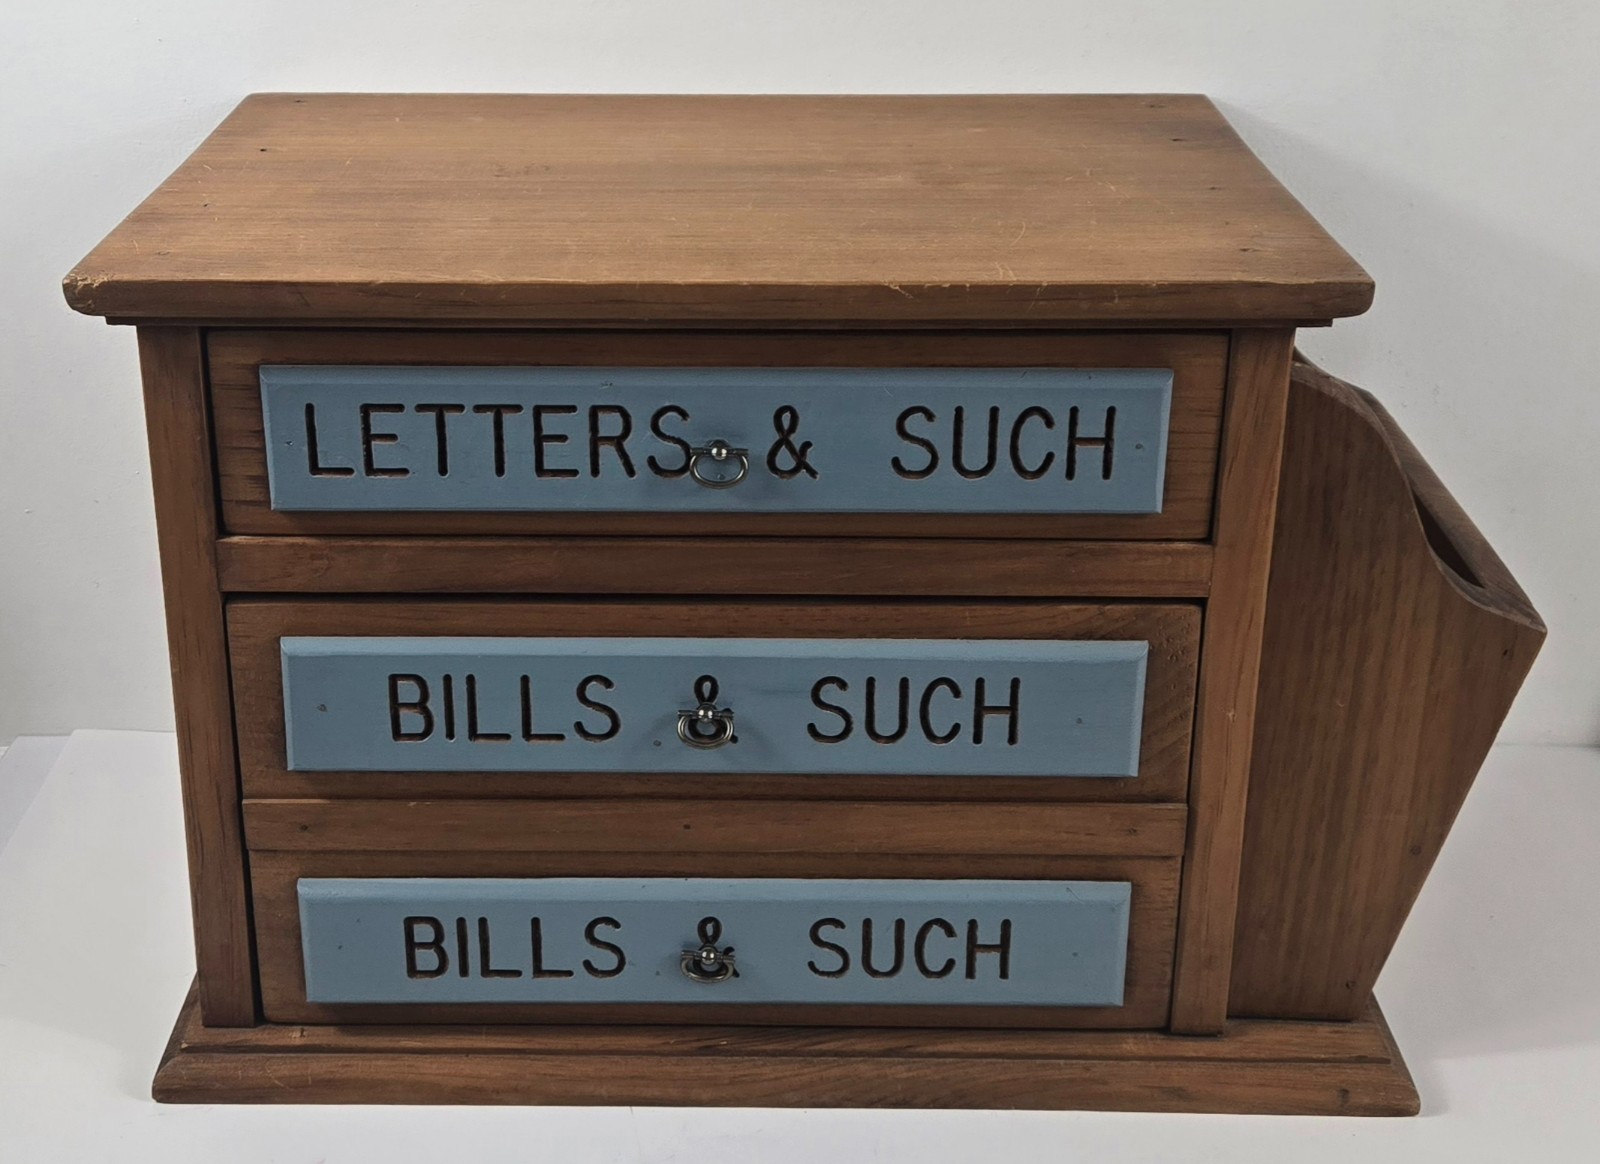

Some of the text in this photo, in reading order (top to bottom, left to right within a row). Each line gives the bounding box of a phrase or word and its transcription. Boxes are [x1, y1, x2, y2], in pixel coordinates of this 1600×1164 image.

[304, 402, 1118, 482] LETTERS & SUCH
[387, 673, 622, 744] BILLS
[806, 675, 1022, 747] SUCH
[403, 915, 627, 980] BILLS
[807, 917, 1013, 981] SUCH
